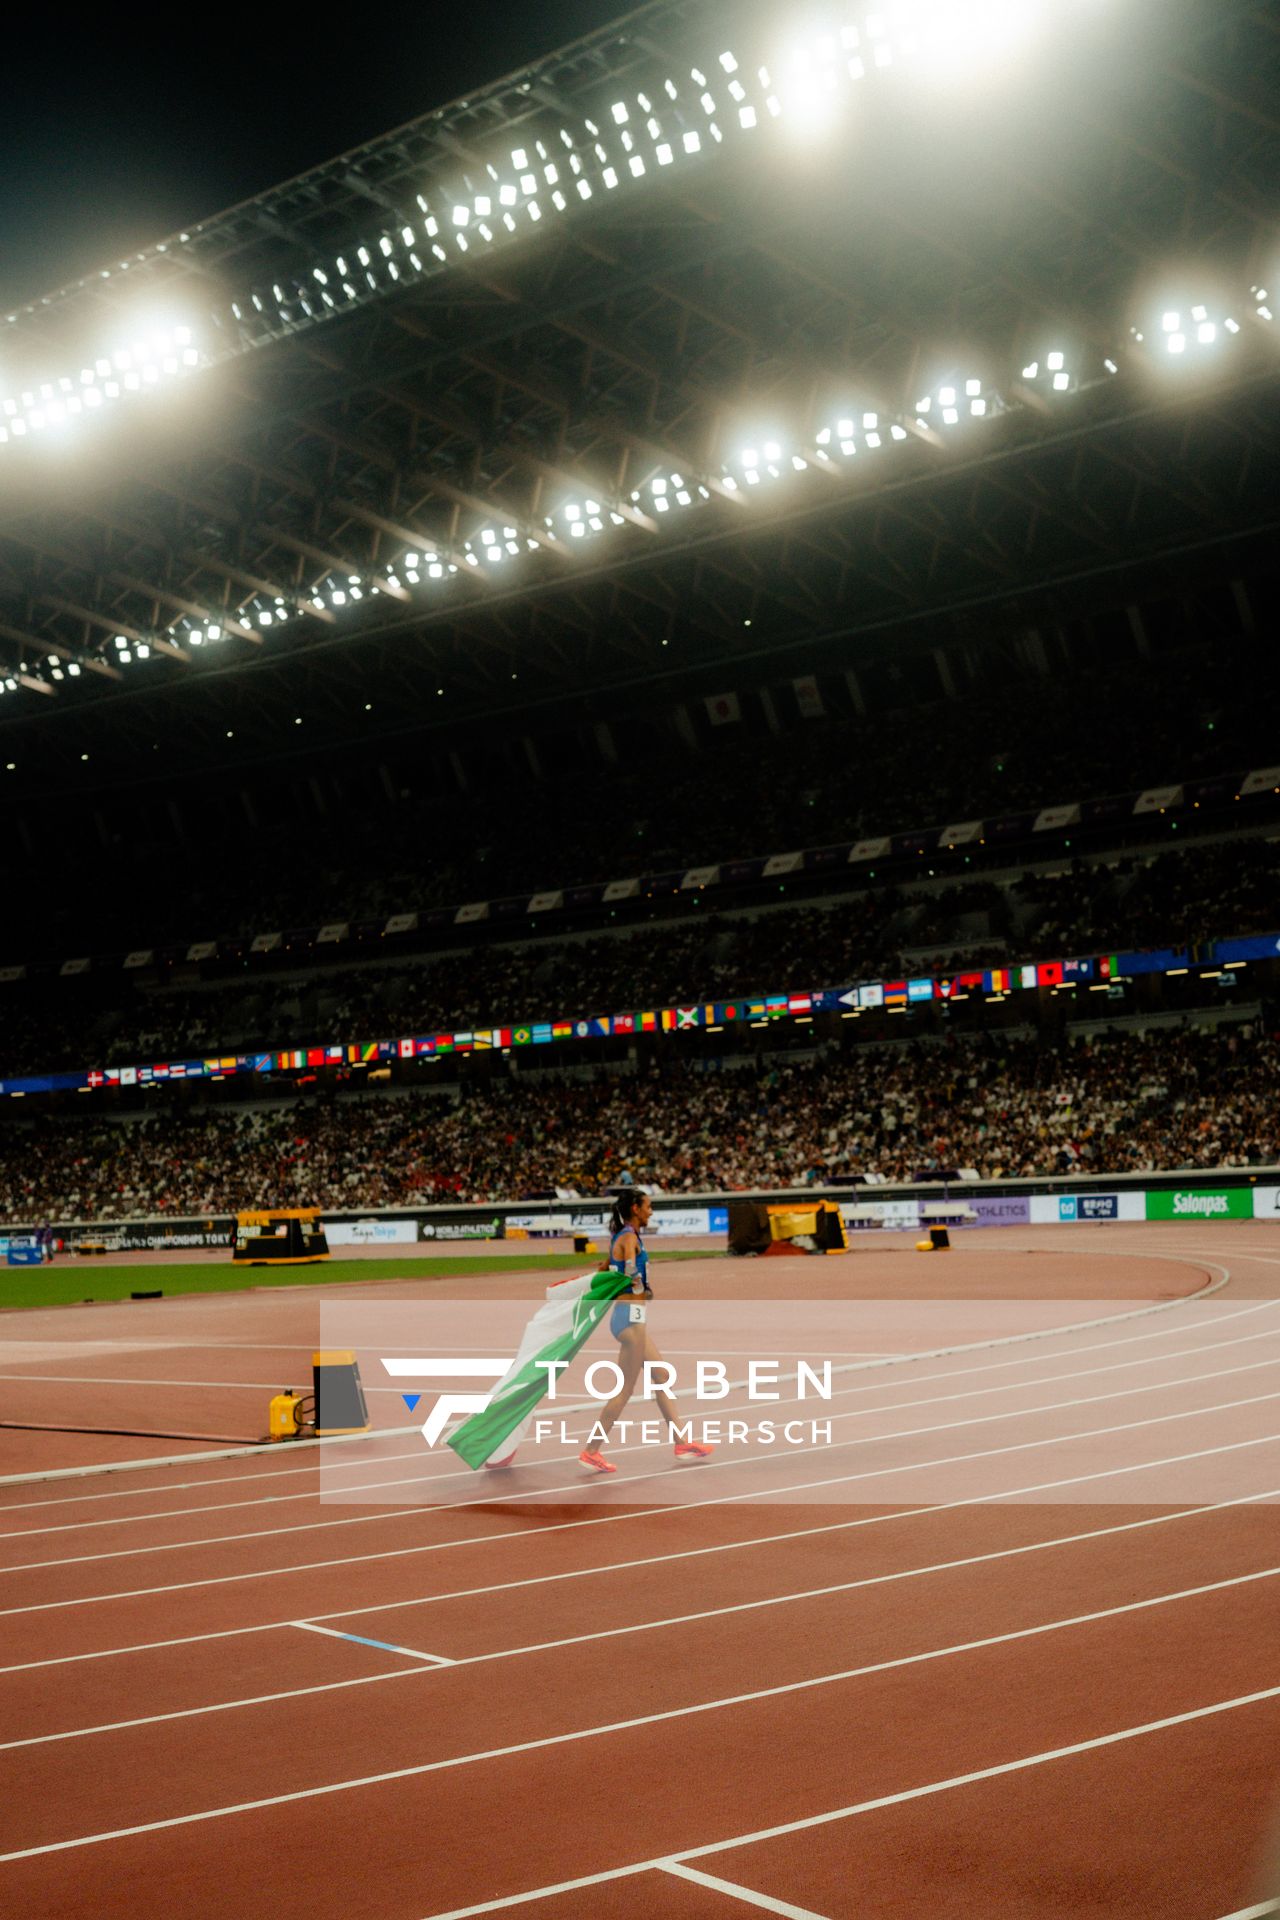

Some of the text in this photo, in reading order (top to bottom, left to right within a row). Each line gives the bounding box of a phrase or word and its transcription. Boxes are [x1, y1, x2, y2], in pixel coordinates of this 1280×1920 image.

[1173, 1193, 1228, 1217] Salonpas
[205, 1233, 231, 1245] TOKY
[634, 1307, 642, 1320] 3
